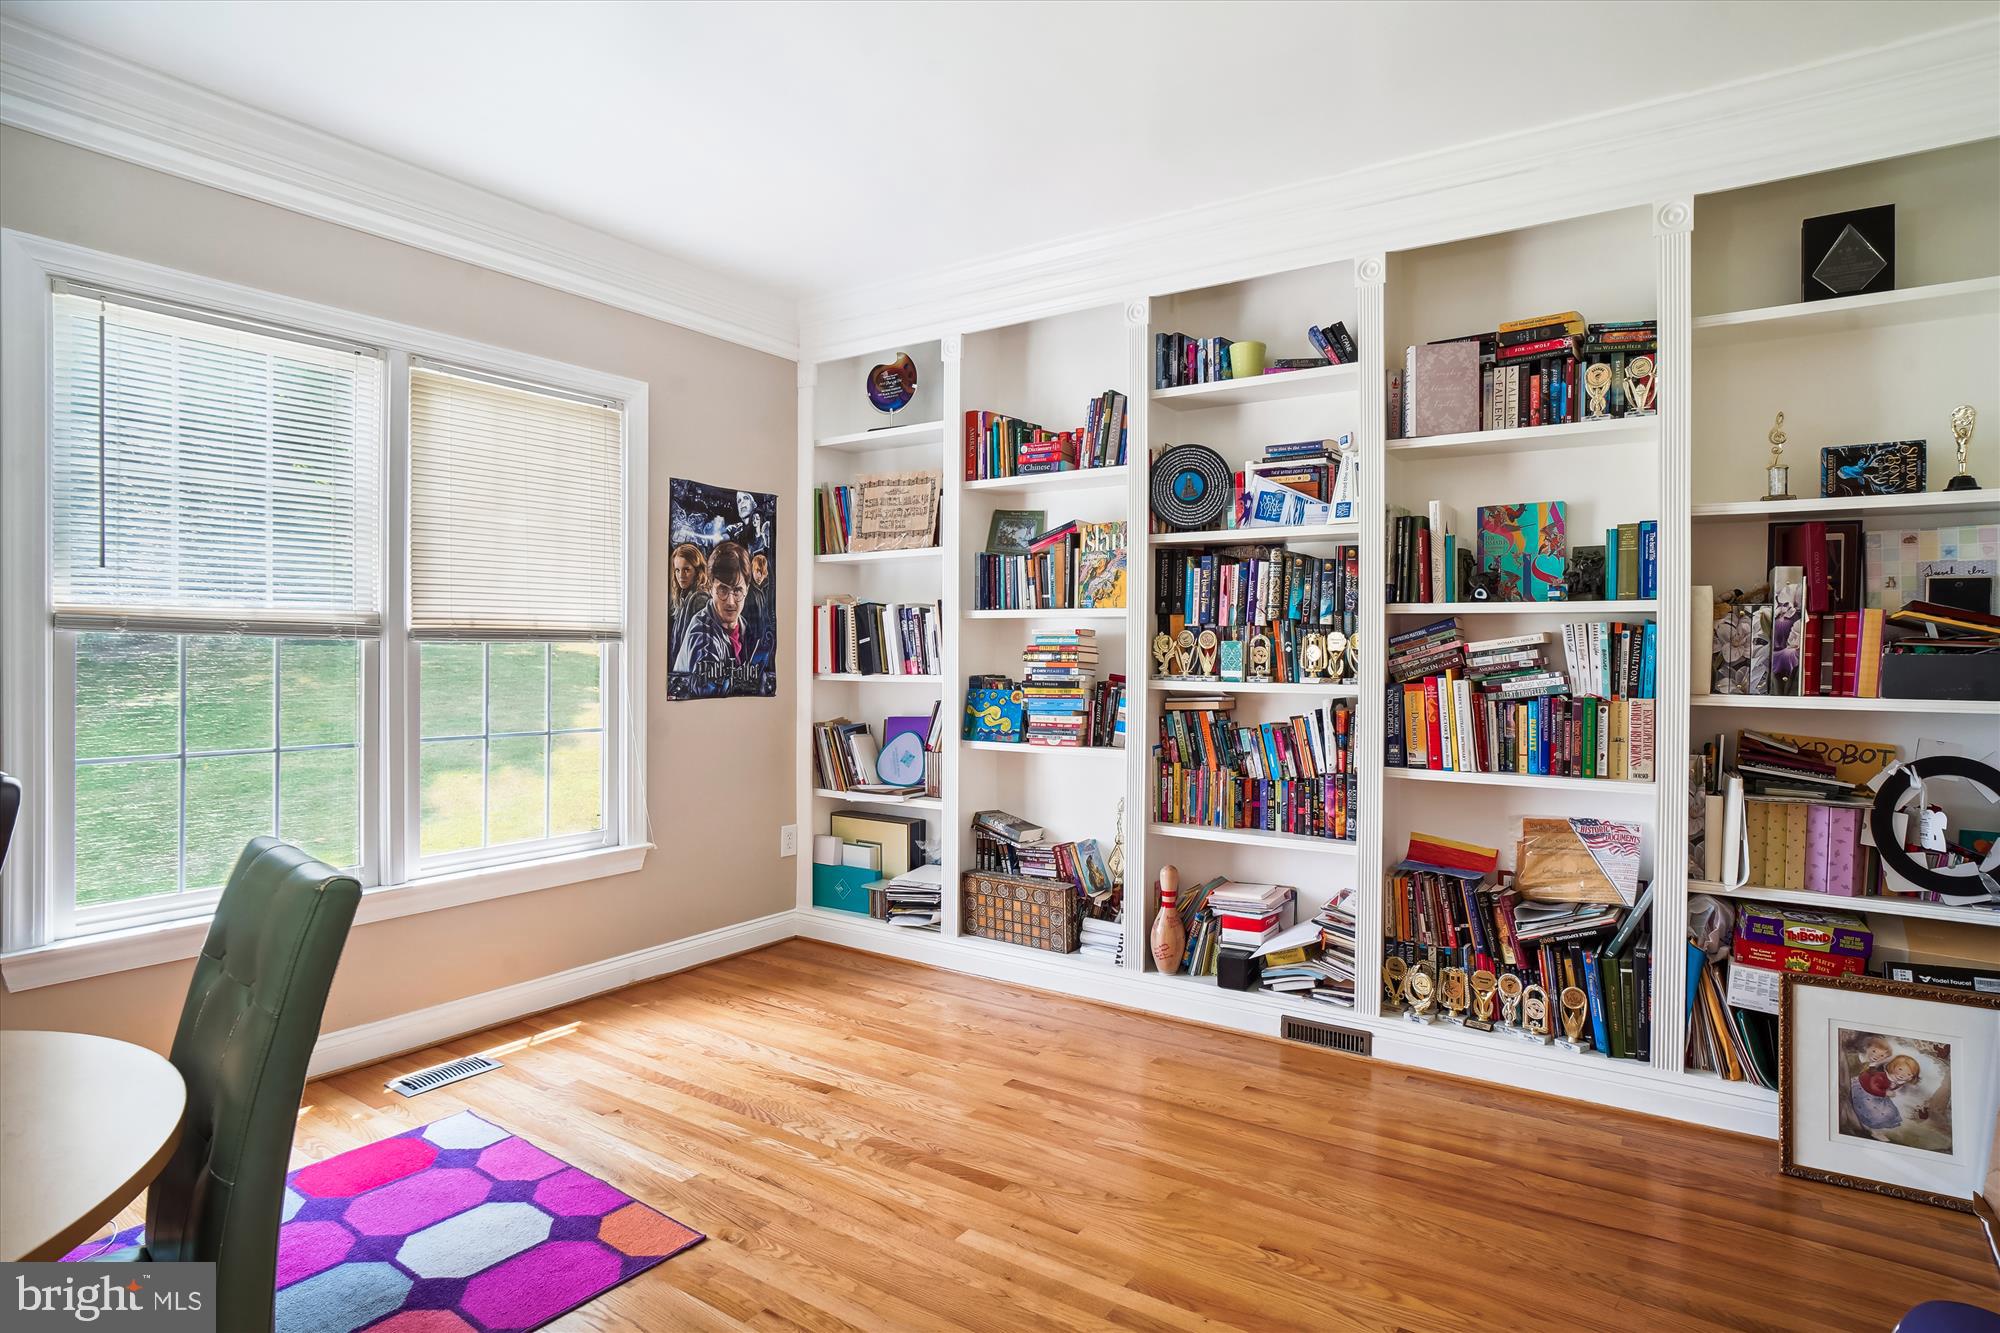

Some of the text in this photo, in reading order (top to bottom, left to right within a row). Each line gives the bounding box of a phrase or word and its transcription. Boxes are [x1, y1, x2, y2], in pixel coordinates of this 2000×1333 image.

[1495, 382, 1503, 420] FALLEN
[1508, 380, 1516, 420] FALLEN
[1024, 463, 1051, 471] Chinese
[1885, 454, 1901, 486] BONE
[1901, 446, 1918, 490] SHADOW
[1260, 509, 1279, 519] LIFE
[1630, 637, 1642, 682] HAMILTON
[1630, 702, 1642, 729] WORLD
[1529, 718, 1537, 752] REALITY
[1630, 730, 1642, 767] RELIGIONS
[1642, 709, 1653, 762] ENCYCLOPEDIA OF
[1580, 825, 1611, 834] HISTORIC
[1605, 834, 1640, 843] DOCUMENTS
[1813, 956, 1836, 968] PARTY
[1816, 965, 1830, 974] BOX
